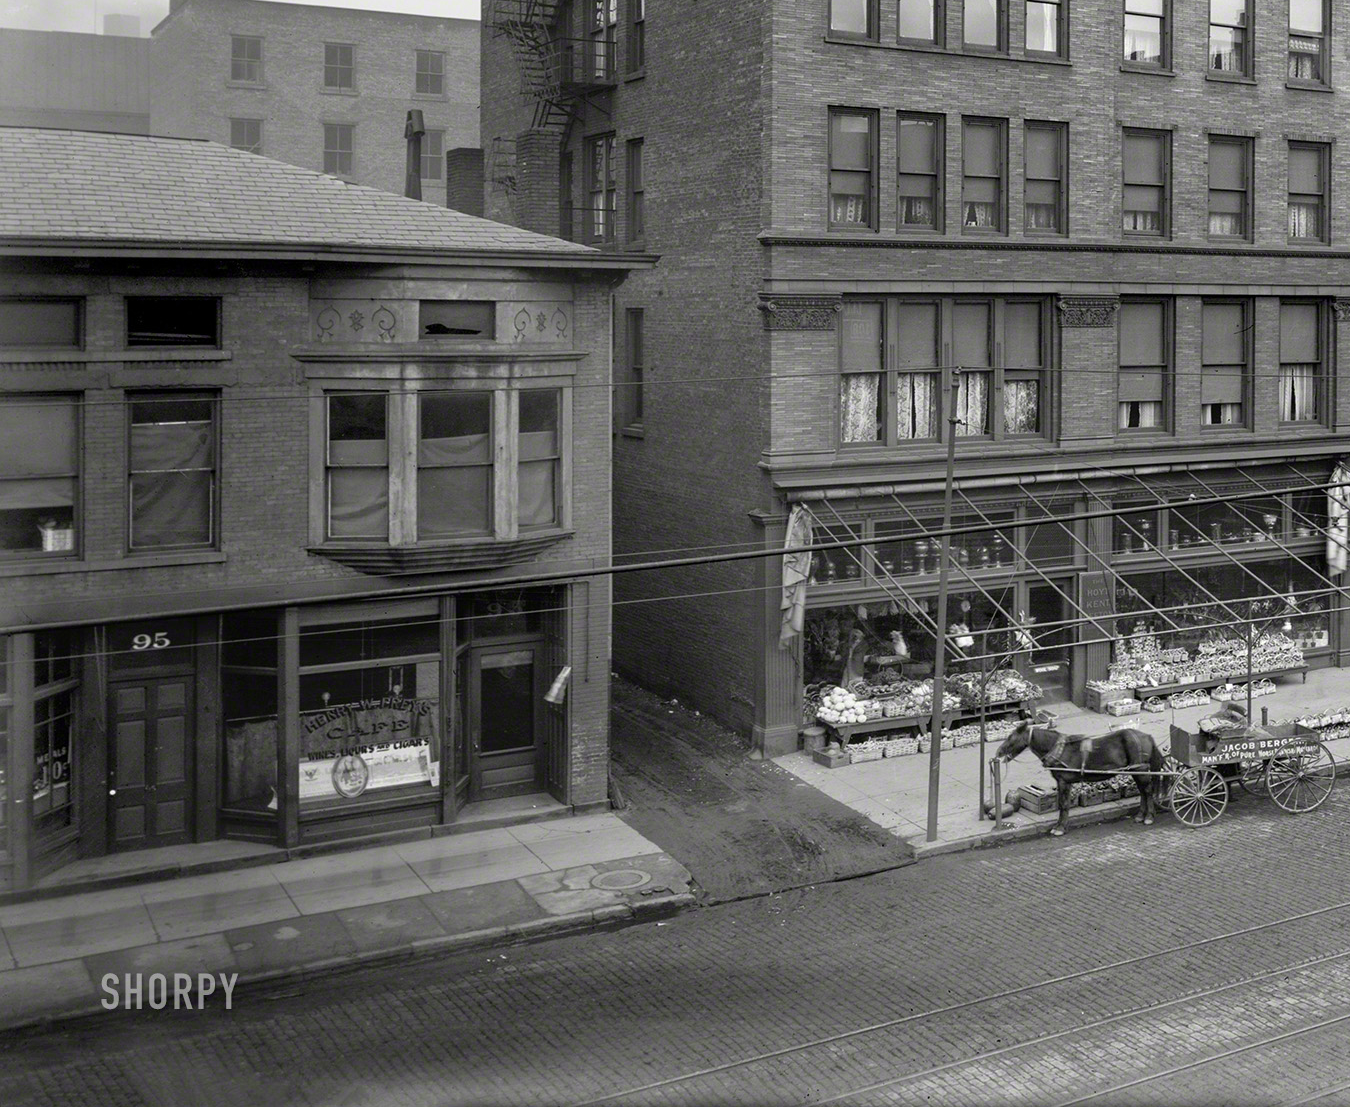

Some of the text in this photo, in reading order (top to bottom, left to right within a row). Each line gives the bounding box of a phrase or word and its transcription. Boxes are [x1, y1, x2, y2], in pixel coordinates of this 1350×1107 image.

[1086, 598, 1110, 609] KENT
[132, 631, 171, 650] 95
[304, 704, 353, 734] HENRY
[326, 719, 410, 740] CAFE
[377, 741, 390, 753] AND
[394, 736, 430, 750] CIGARS
[1221, 741, 1255, 753] JACOB
